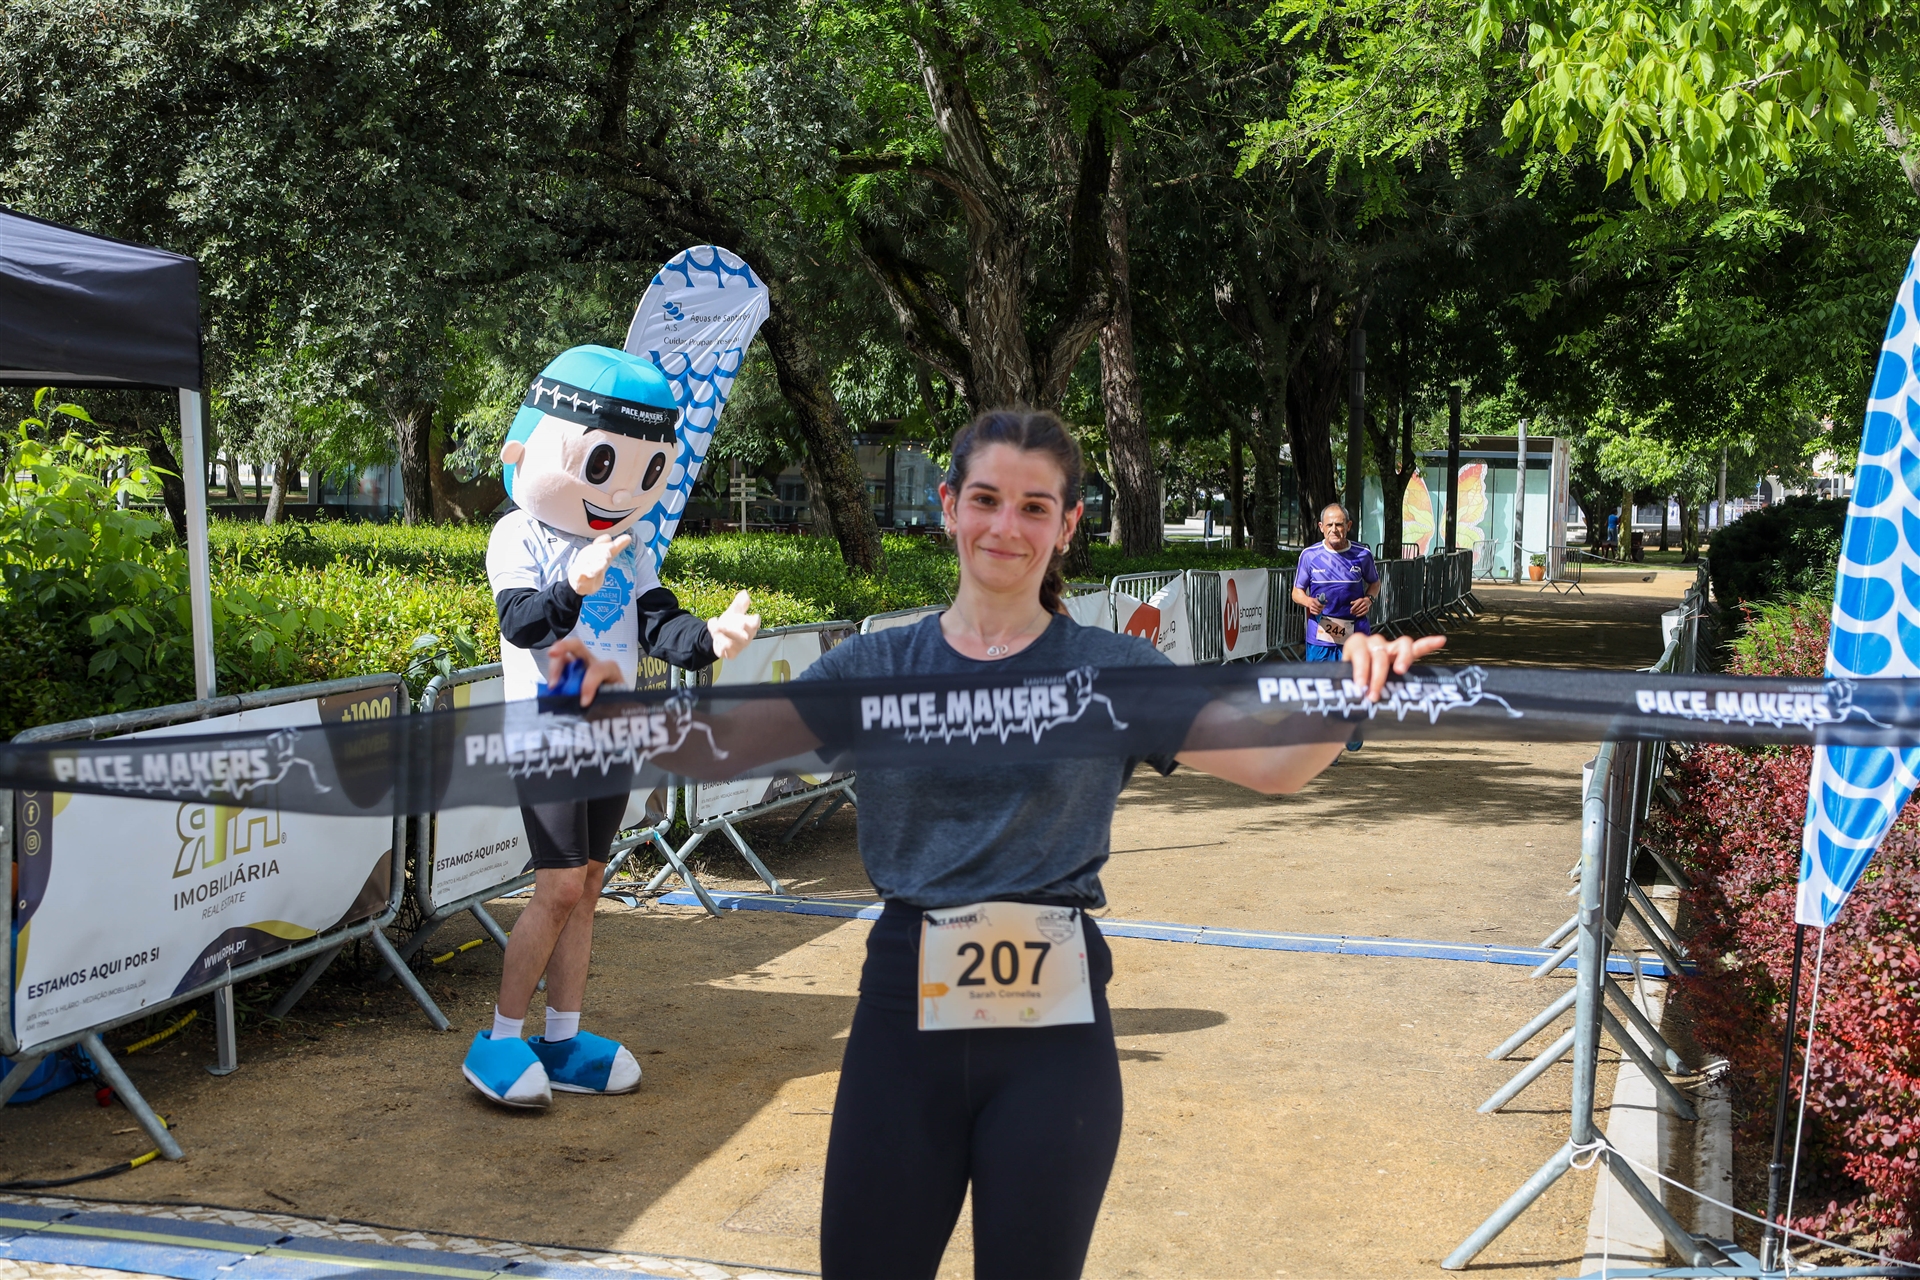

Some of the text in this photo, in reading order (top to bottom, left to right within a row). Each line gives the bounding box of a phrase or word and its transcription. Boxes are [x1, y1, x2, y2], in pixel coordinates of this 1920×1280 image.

[690, 312, 711, 324] Águas
[712, 314, 721, 322] de
[1240, 605, 1263, 620] shopping
[1326, 624, 1346, 637] 244
[436, 836, 519, 872] ESTAMOS AQUI POR SI
[173, 859, 280, 911] IMOBILIÁRIA
[202, 891, 247, 920] REAL ESTATE
[28, 946, 160, 1000] ESTAMOS AQUI POR SI
[957, 940, 1052, 987] 207
[969, 990, 996, 999] Sarah
